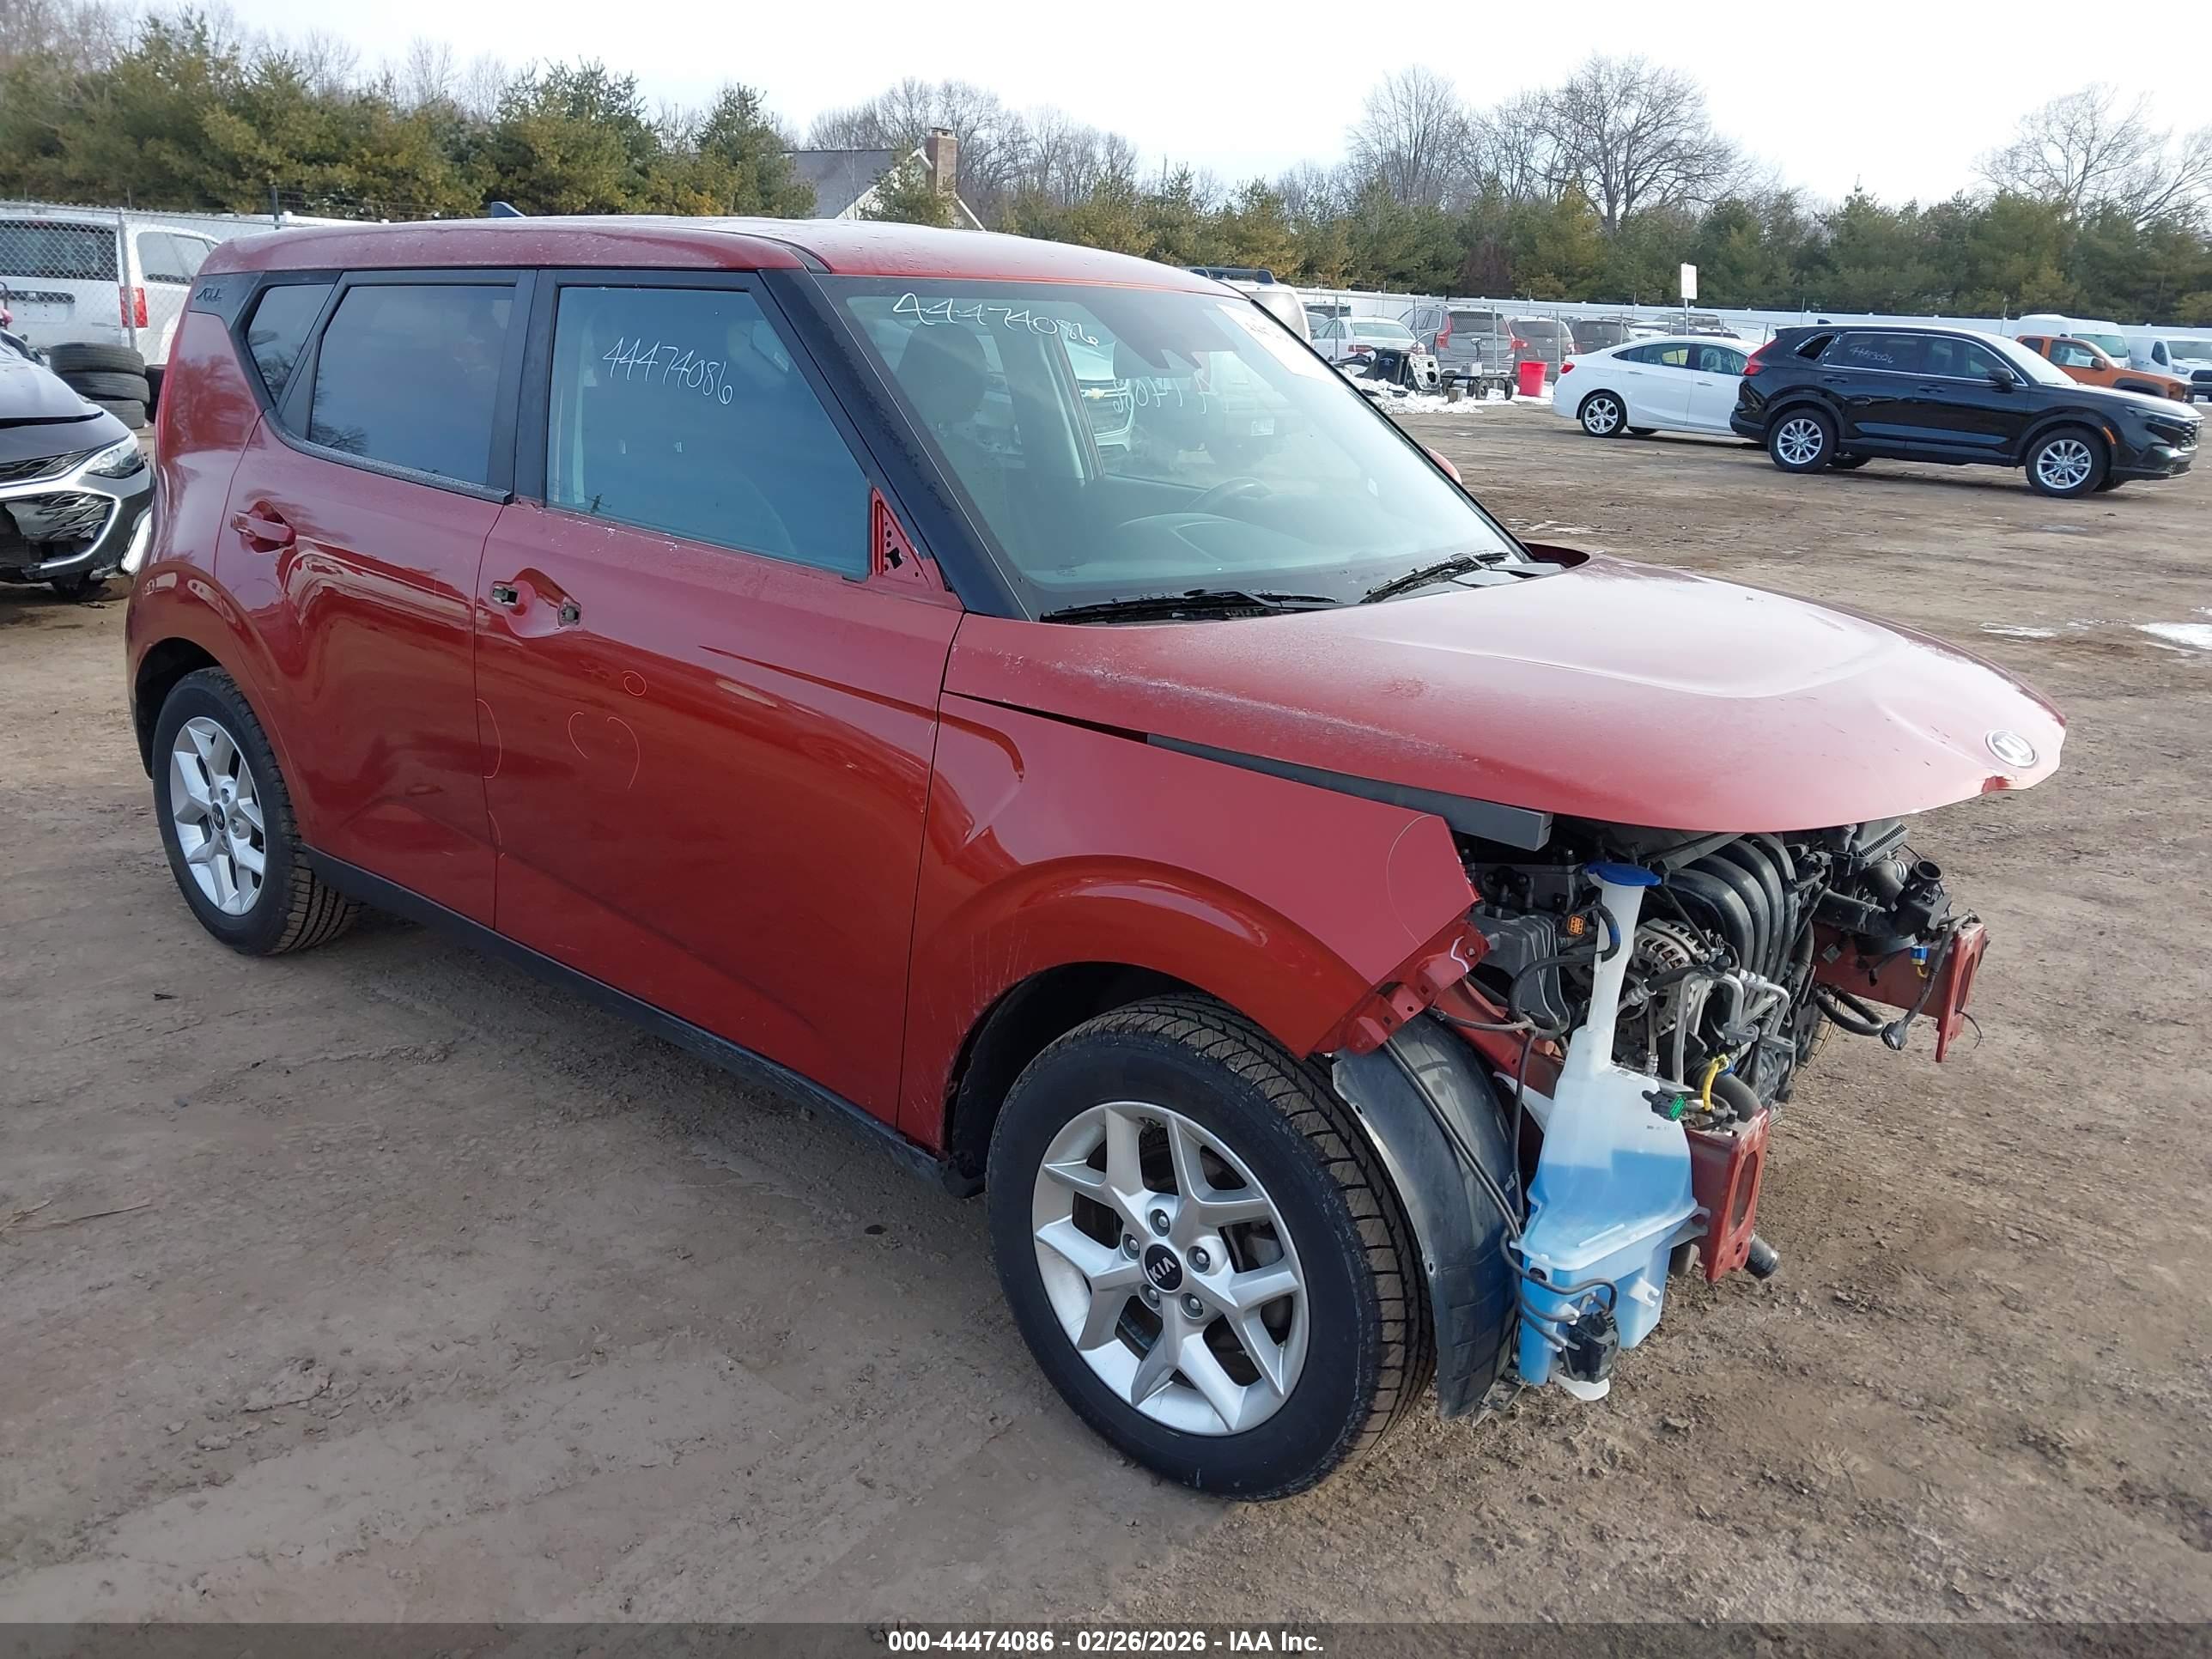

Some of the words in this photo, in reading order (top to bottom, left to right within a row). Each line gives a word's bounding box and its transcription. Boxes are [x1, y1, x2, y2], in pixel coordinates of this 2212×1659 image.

[892, 292, 1100, 348] 44474086
[602, 337, 733, 405] 44474086
[1149, 1256, 1176, 1282] KIA
